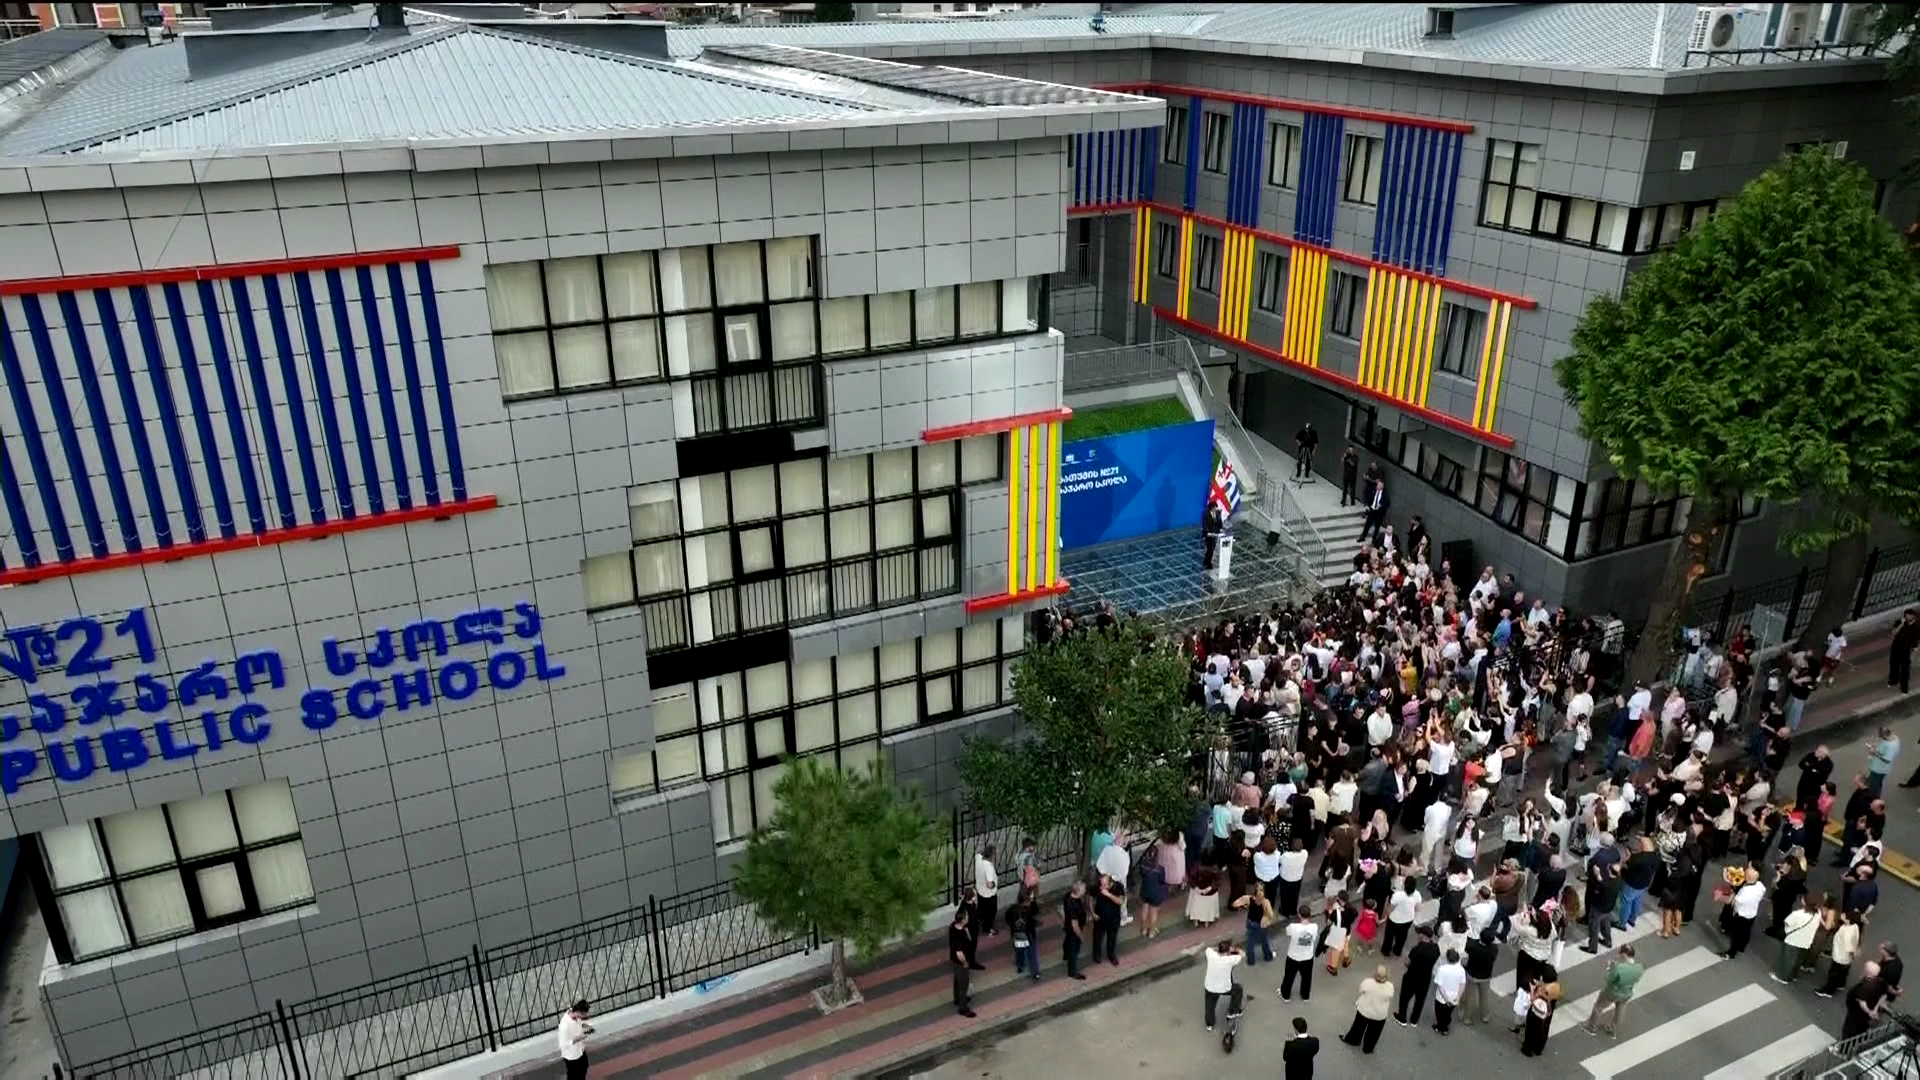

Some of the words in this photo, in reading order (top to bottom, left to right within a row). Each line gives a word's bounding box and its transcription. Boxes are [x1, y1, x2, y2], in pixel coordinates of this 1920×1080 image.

[1060, 481, 1093, 494] აჯარო
[321, 602, 542, 676] სკოლა
[0, 700, 273, 796] PUBLIC
[300, 643, 566, 733] SCHOOL
